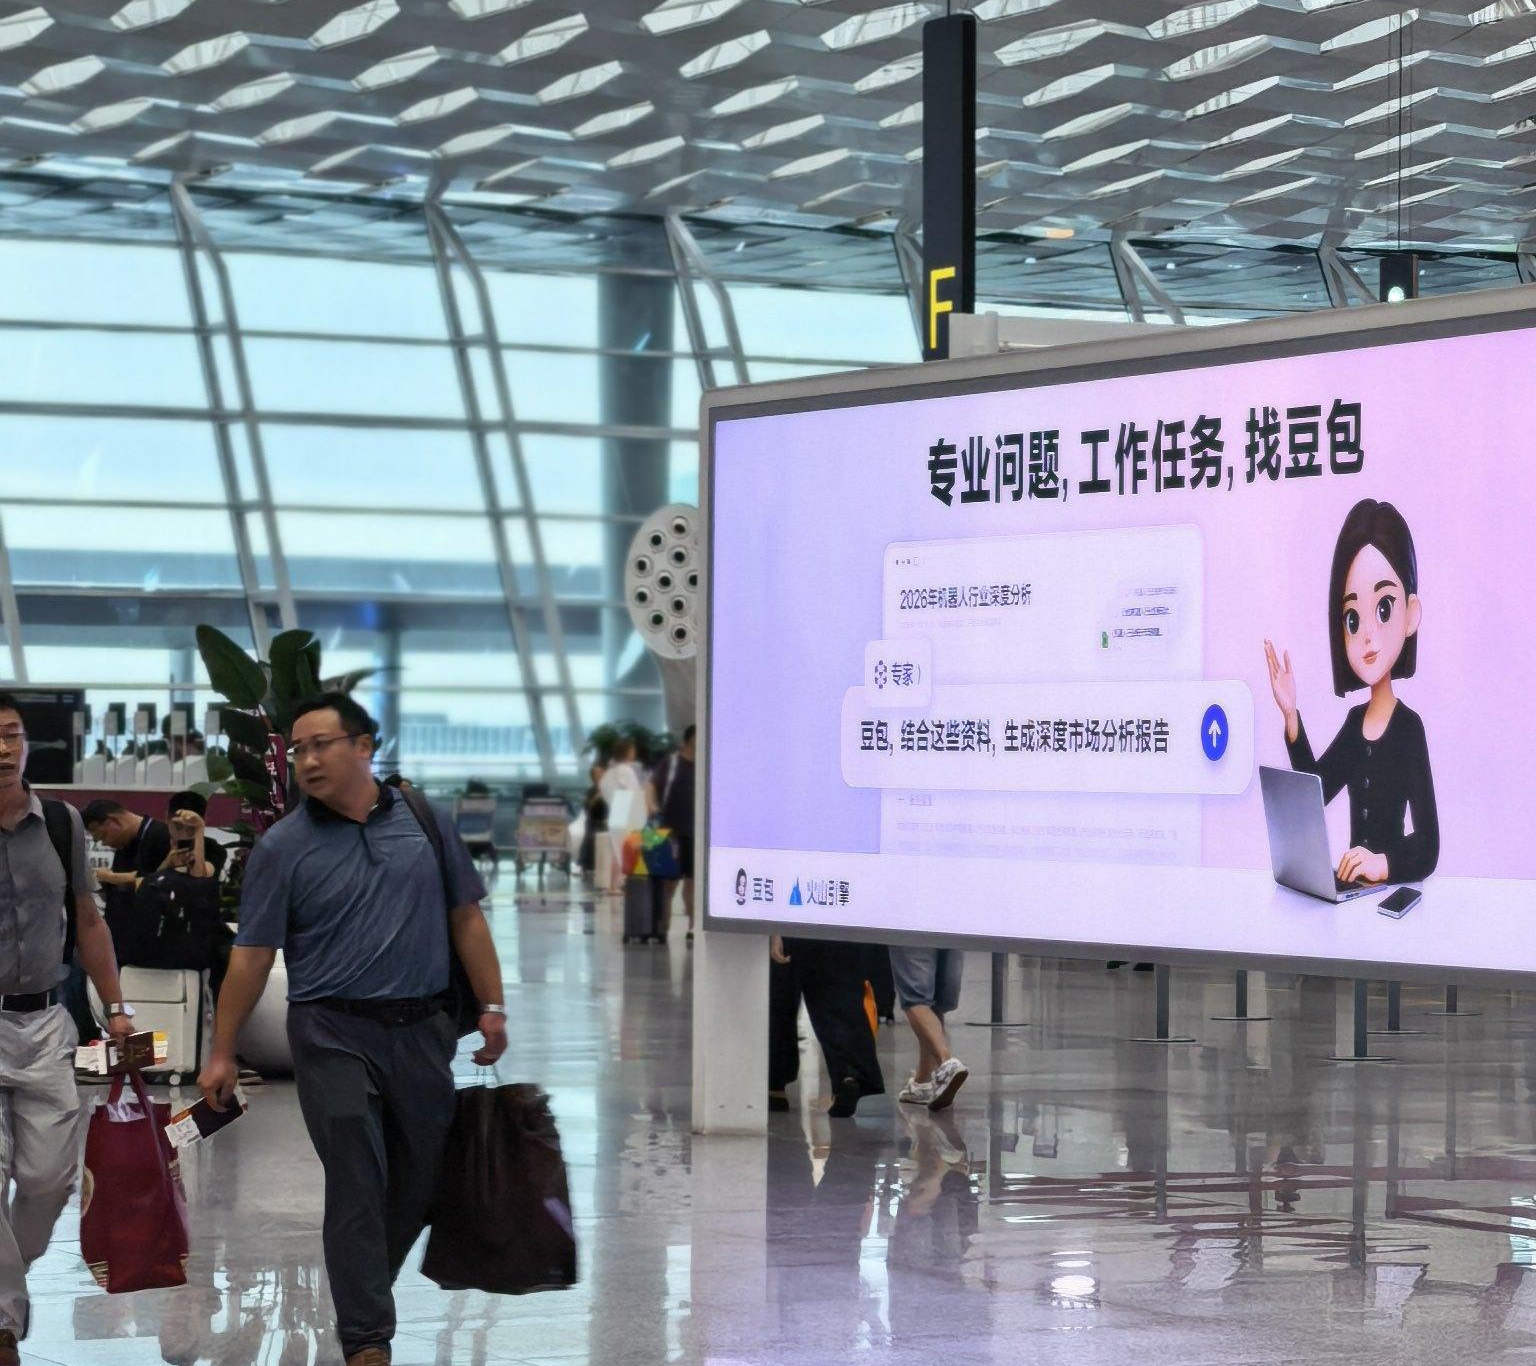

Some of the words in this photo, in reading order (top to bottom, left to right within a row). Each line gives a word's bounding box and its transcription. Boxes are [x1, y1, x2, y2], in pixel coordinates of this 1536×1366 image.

[930, 266, 956, 349] F
[891, 661, 914, 686] 专家
[752, 877, 774, 902] 豆包
